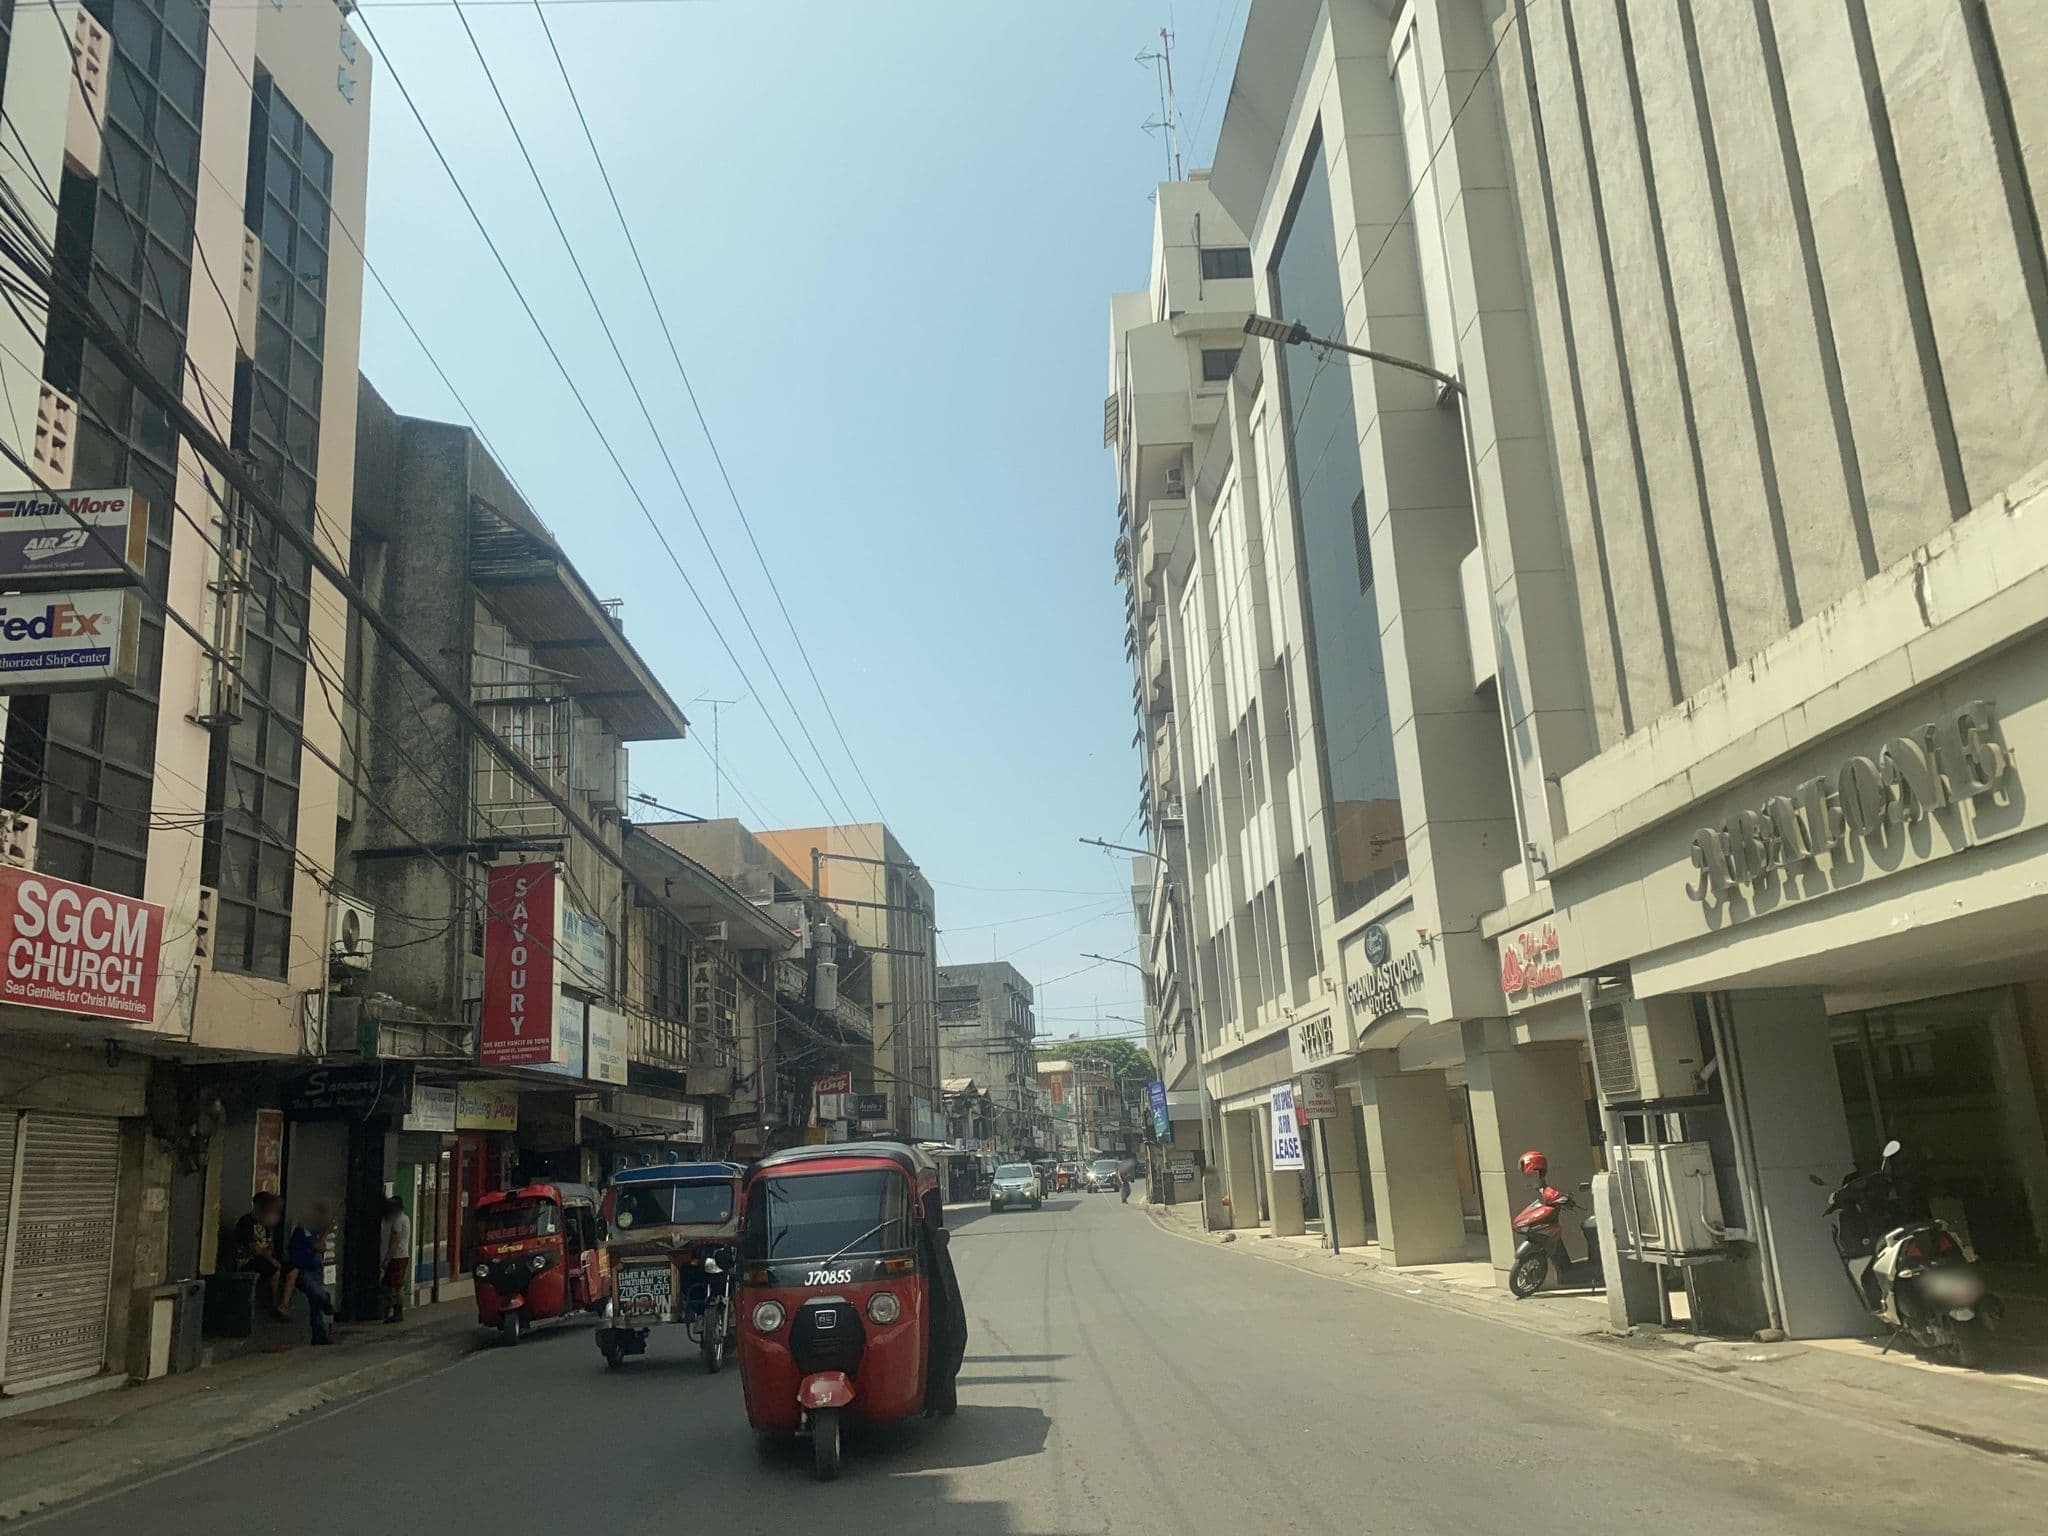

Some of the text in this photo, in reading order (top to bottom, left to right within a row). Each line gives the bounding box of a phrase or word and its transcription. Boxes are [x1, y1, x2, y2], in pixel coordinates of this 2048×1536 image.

[14, 497, 124, 517] Mail More
[24, 537, 57, 551] AIR
[46, 652, 107, 668] ShipCenter
[14, 880, 149, 958] SGCM
[8, 938, 143, 997] CHURCH
[510, 878, 529, 1036] SAVOURY
[1347, 952, 1420, 1005] GRAND ASTORIA
[5, 980, 146, 1013] Sea Gentiles for Christ Ministries
[1369, 990, 1396, 1014] HOTEL
[1275, 1137, 1300, 1159] LEASE
